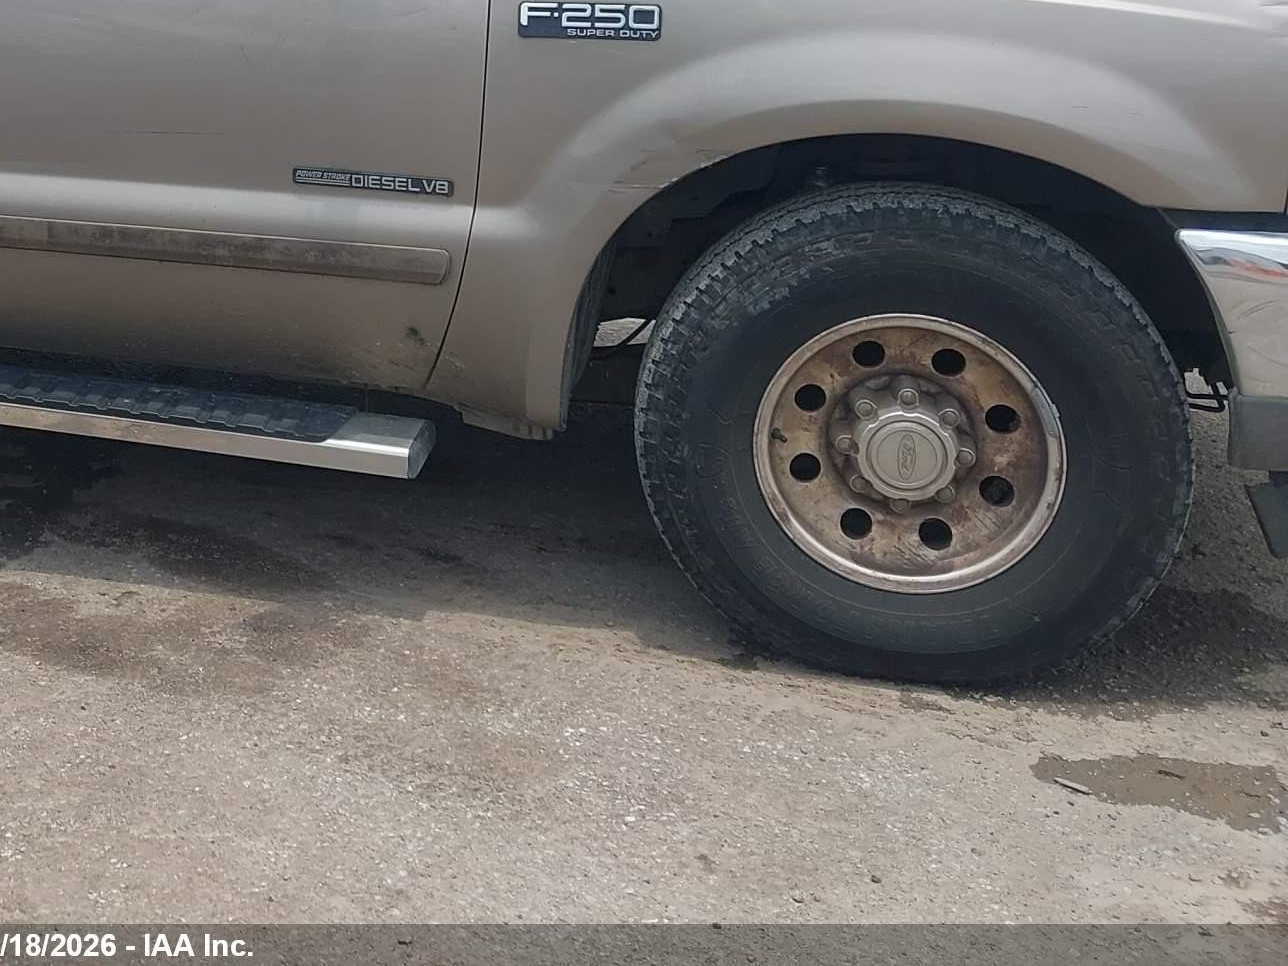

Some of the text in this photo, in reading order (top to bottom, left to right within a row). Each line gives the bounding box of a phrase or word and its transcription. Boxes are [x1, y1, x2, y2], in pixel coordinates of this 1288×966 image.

[567, 28, 659, 39] SUPER DUTY
[295, 170, 449, 194] POWER STROKE DIESEL V8
